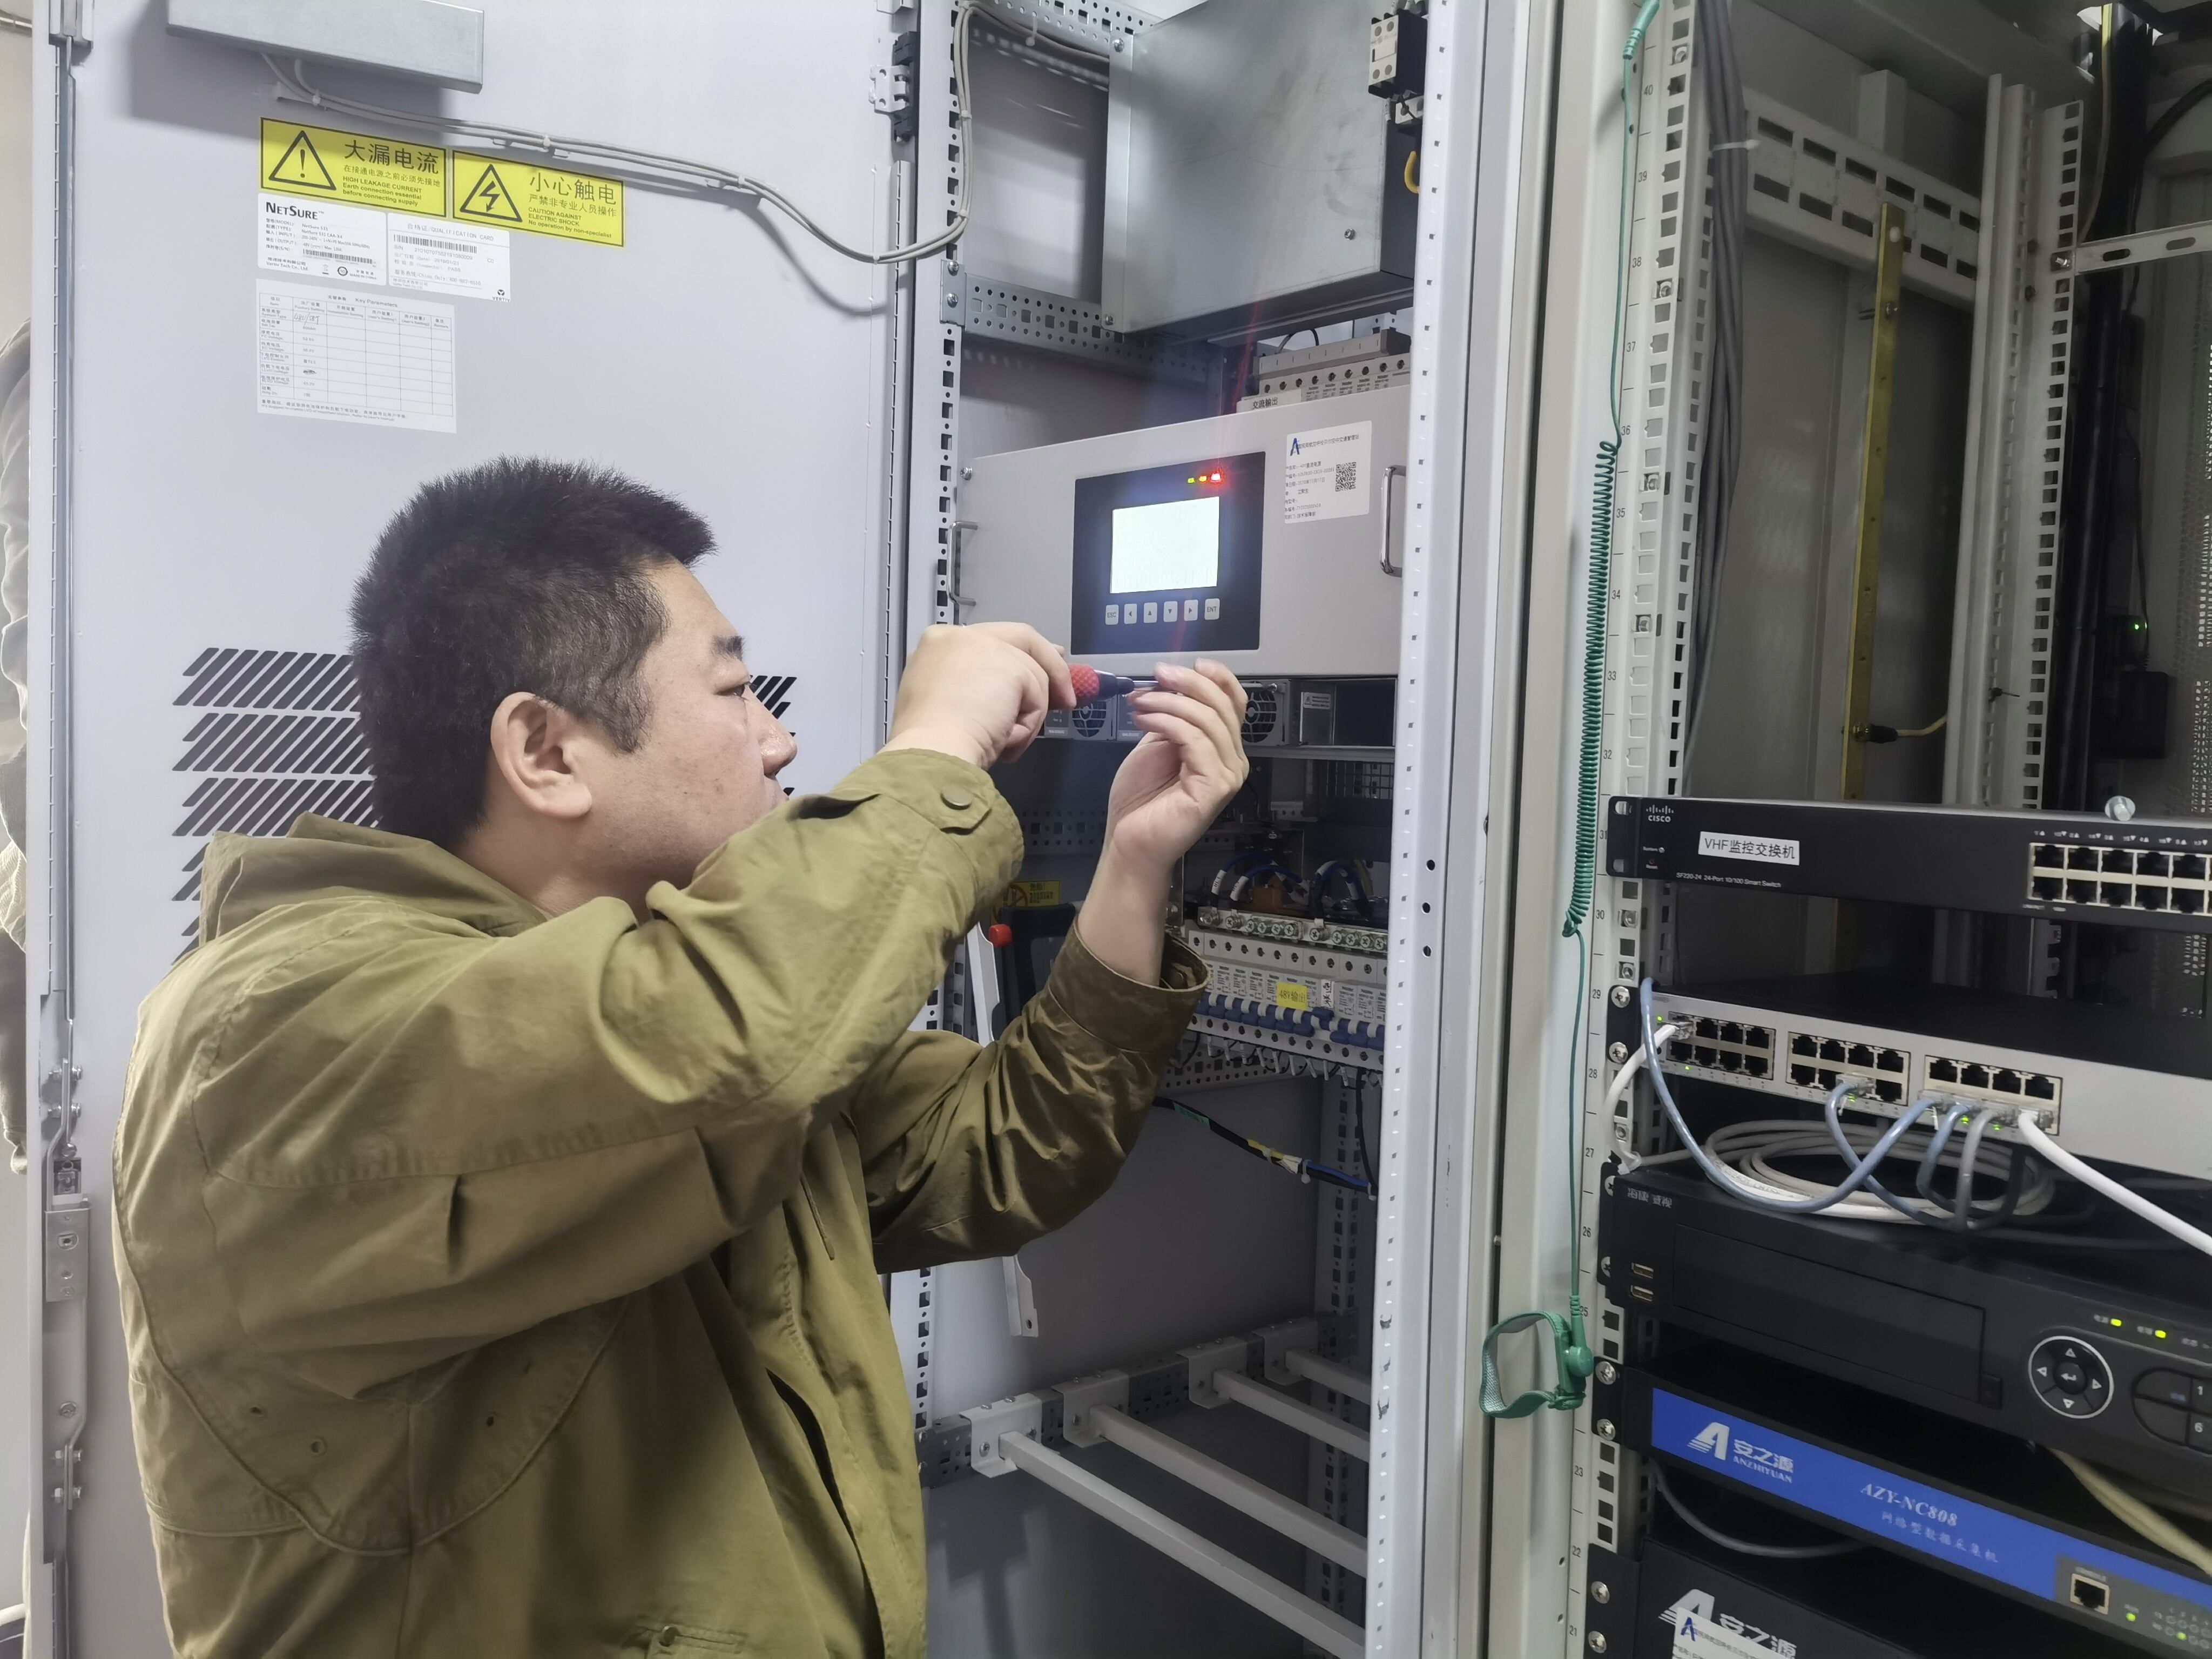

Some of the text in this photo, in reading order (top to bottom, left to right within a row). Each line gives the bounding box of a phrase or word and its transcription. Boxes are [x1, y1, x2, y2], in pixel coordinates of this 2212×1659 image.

[1644, 84, 1654, 96] 40
[345, 139, 439, 174] 大漏电流
[343, 164, 441, 187] 在接通电源之前必须先接地
[1637, 171, 1648, 182] 39
[360, 178, 390, 188] LEAKAGE
[392, 184, 422, 193] CURRENT
[530, 172, 616, 205] 小心触电
[360, 185, 394, 195] connection
[395, 192, 422, 200] essential
[363, 193, 397, 203] connecting
[398, 199, 418, 207] supply
[529, 193, 617, 217] 严禁非专业人员操作
[528, 207, 582, 220] CAUTION AGAINST
[528, 213, 580, 226] ELECTRIC SHOCK
[538, 221, 564, 230] operation
[574, 228, 611, 238] non-specialist
[1632, 257, 1642, 267] 38
[367, 299, 398, 308] Parameters
[1626, 341, 1636, 352] 37
[1621, 424, 1631, 436] 36
[1616, 508, 1626, 518] 35
[1611, 589, 1621, 600] 34
[1607, 671, 1617, 681] 33
[1603, 750, 1612, 760] 32
[1600, 830, 1607, 839] 31
[1704, 838, 1796, 859] VHF监控交换机
[1596, 909, 1605, 920] 30
[1592, 989, 1602, 999] 29
[1588, 1068, 1598, 1078] 28
[1585, 1147, 1595, 1158] 27
[1582, 1226, 1591, 1237] 26
[2197, 1386, 2203, 1395] 1
[2194, 1422, 2203, 1432] 6
[1733, 1439, 1793, 1473] 安之源
[1574, 1466, 1583, 1477] 23
[1733, 1455, 1792, 1483] ANZHIYUAN
[1860, 1483, 1958, 1526] AZY-NC808
[1572, 1546, 1581, 1557] 22
[1569, 1625, 1577, 1636] 21
